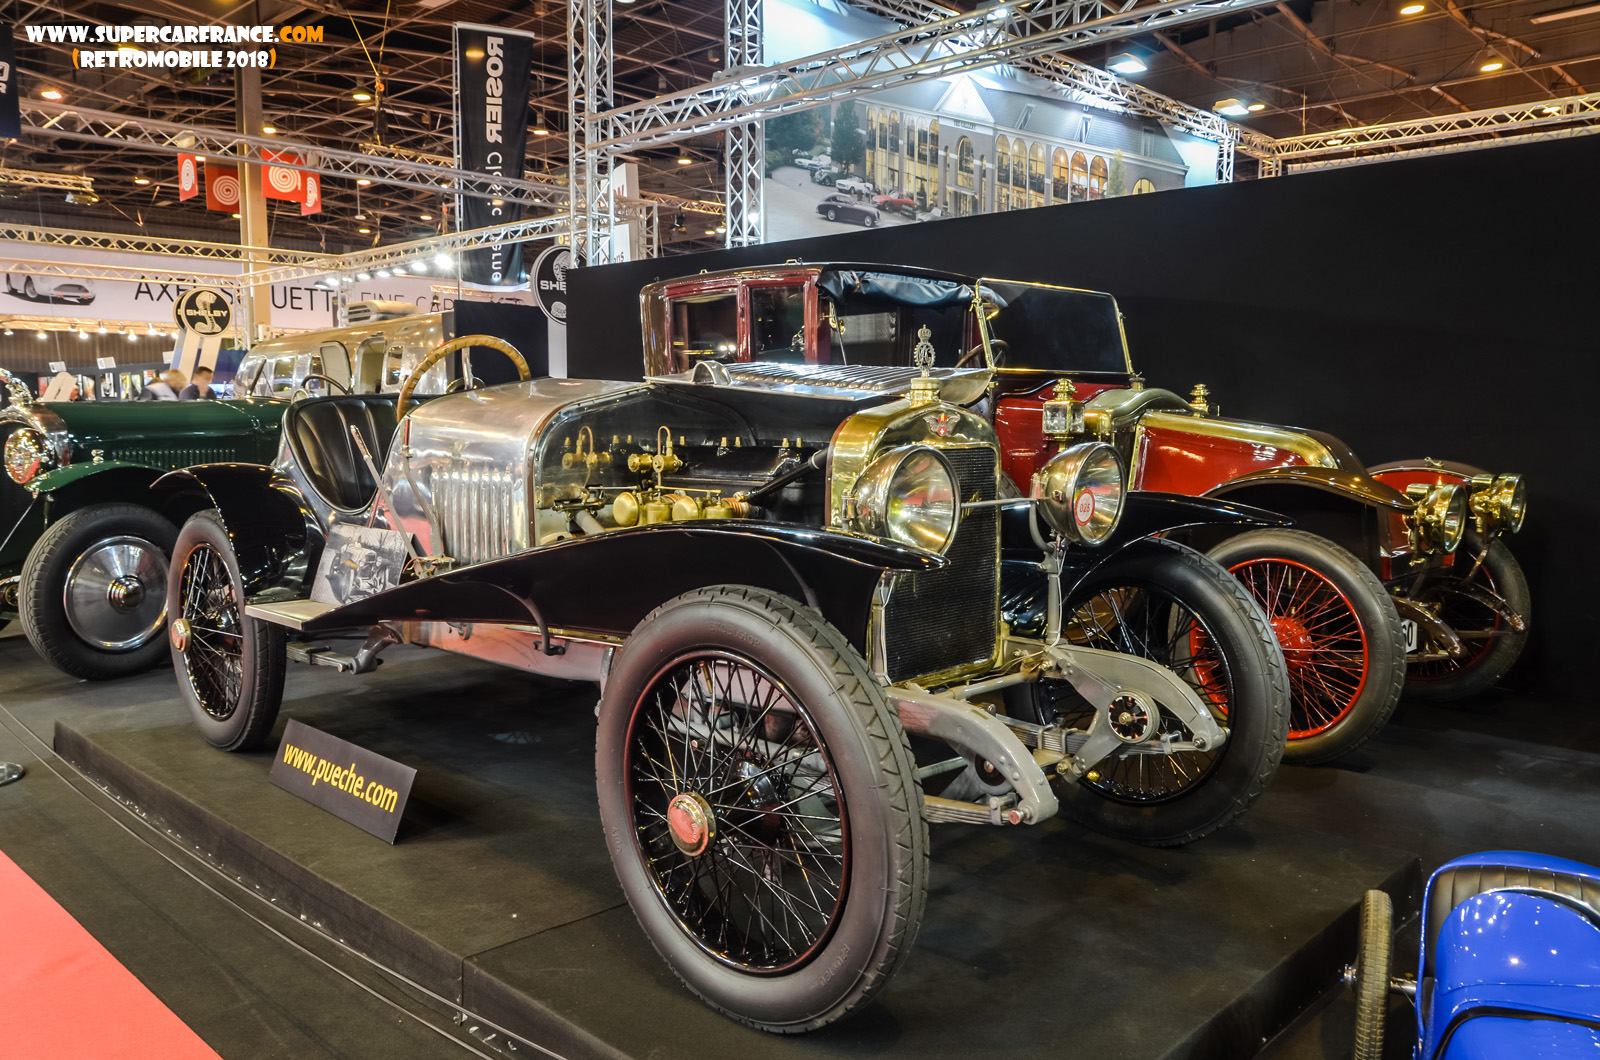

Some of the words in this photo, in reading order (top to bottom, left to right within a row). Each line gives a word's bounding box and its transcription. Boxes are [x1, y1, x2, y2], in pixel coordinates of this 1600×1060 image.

[134, 275, 197, 302] AXE
[186, 308, 228, 317] SHELBY
[283, 743, 399, 813] www.pueche.com
